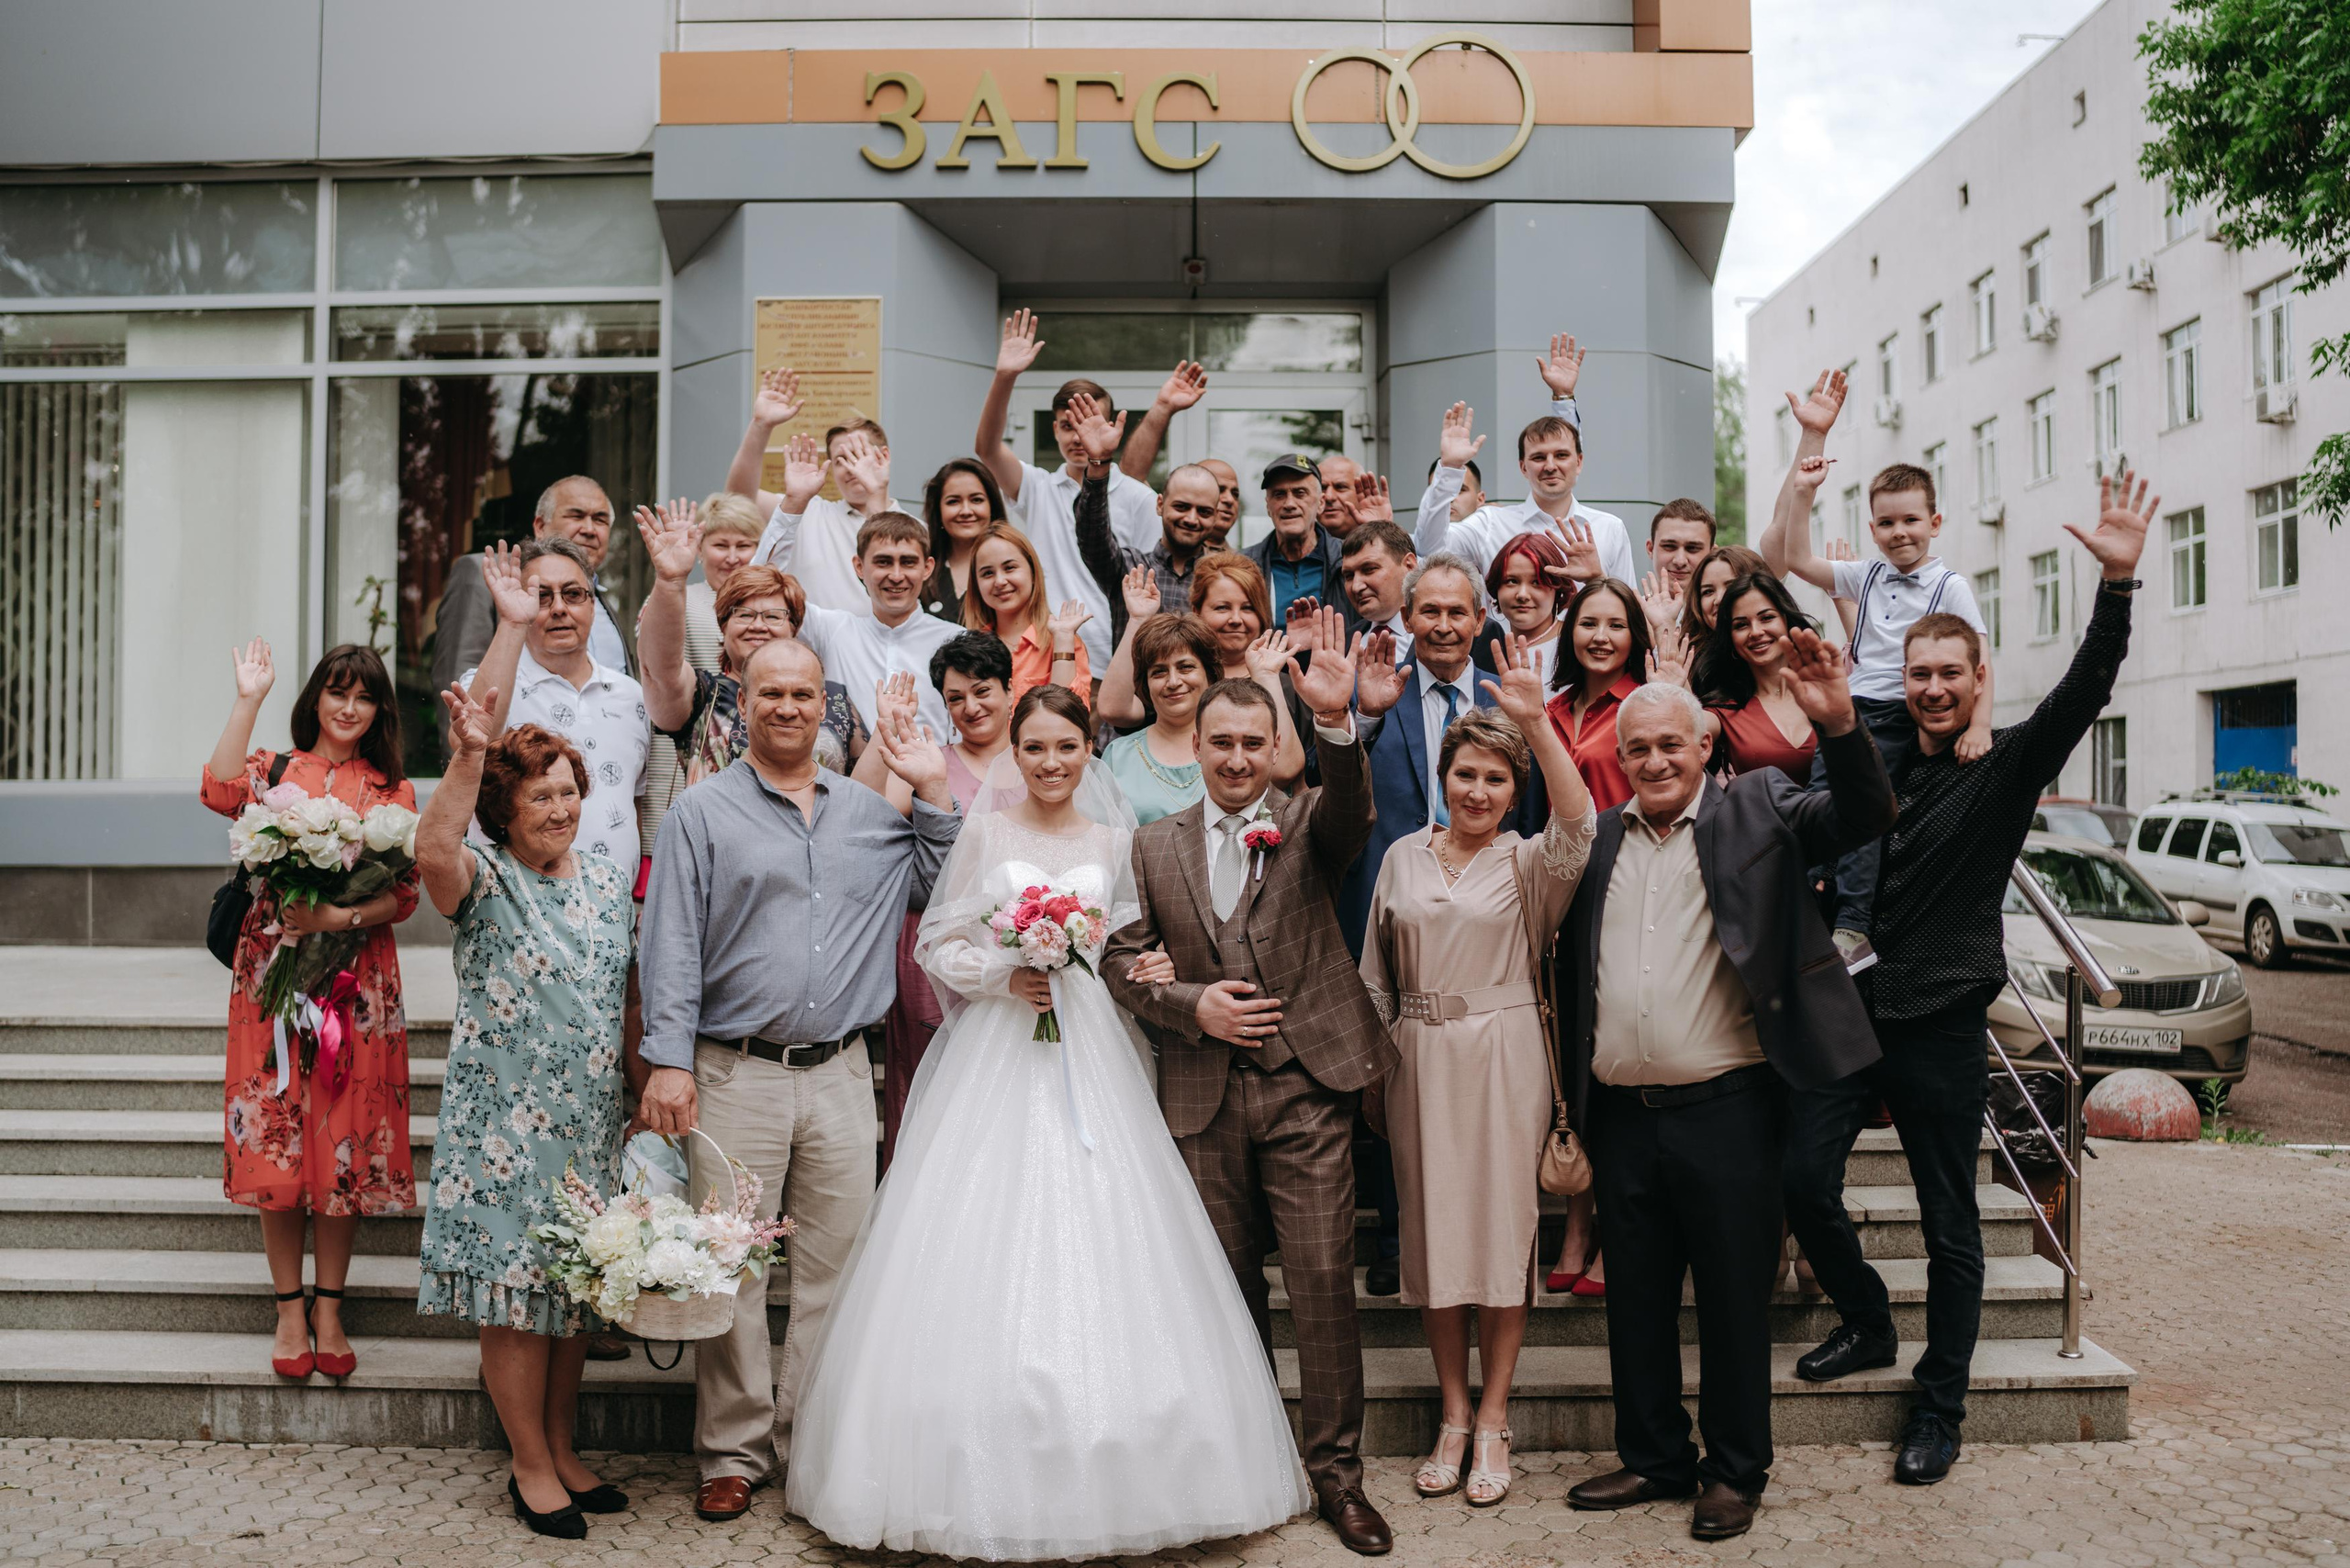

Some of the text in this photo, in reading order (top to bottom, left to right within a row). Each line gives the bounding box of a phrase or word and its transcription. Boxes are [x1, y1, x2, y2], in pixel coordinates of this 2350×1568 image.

[860, 70, 1221, 173] ЗАГС
[2088, 1028, 2151, 1047] Р664НХ
[2154, 1031, 2177, 1044] 102
